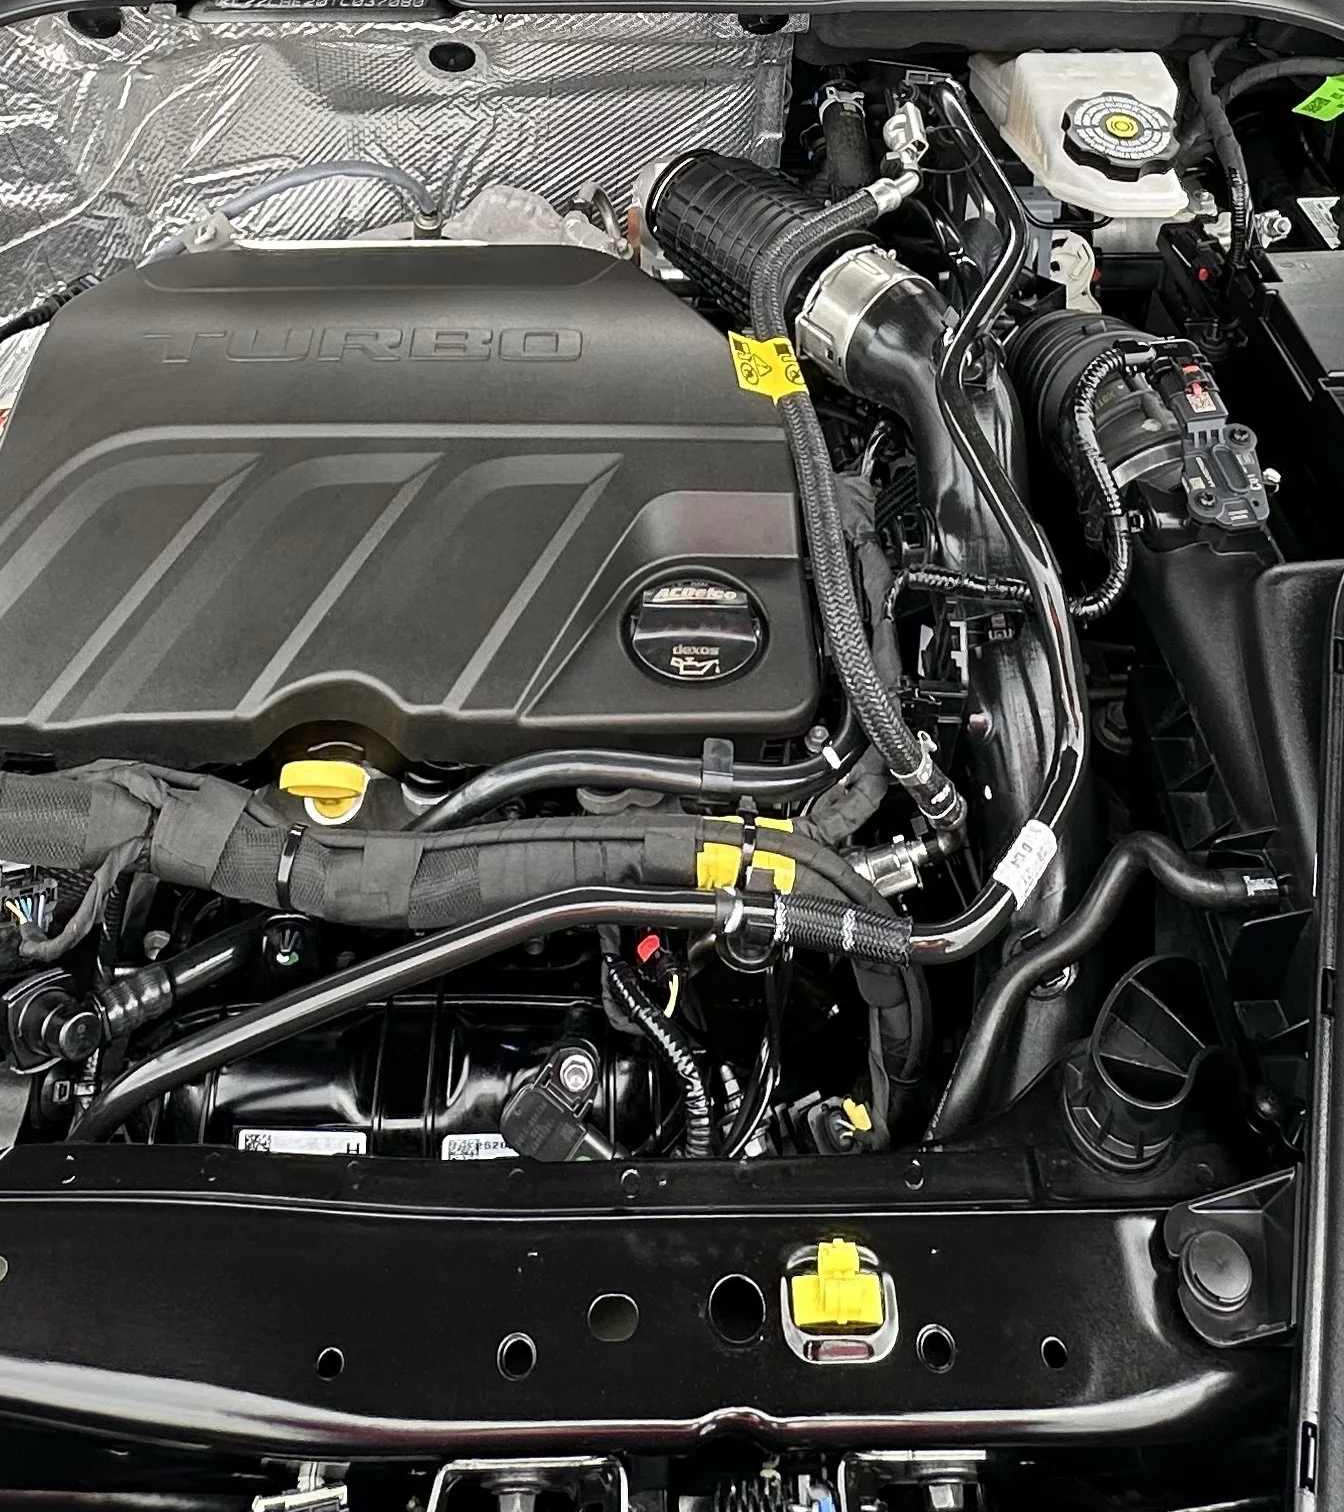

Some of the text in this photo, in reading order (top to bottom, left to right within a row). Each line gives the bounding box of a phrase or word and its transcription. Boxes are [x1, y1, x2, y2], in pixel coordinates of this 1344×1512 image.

[143, 327, 584, 364] TURBO
[652, 587, 738, 603] ACDelco
[672, 644, 721, 656] dexos
